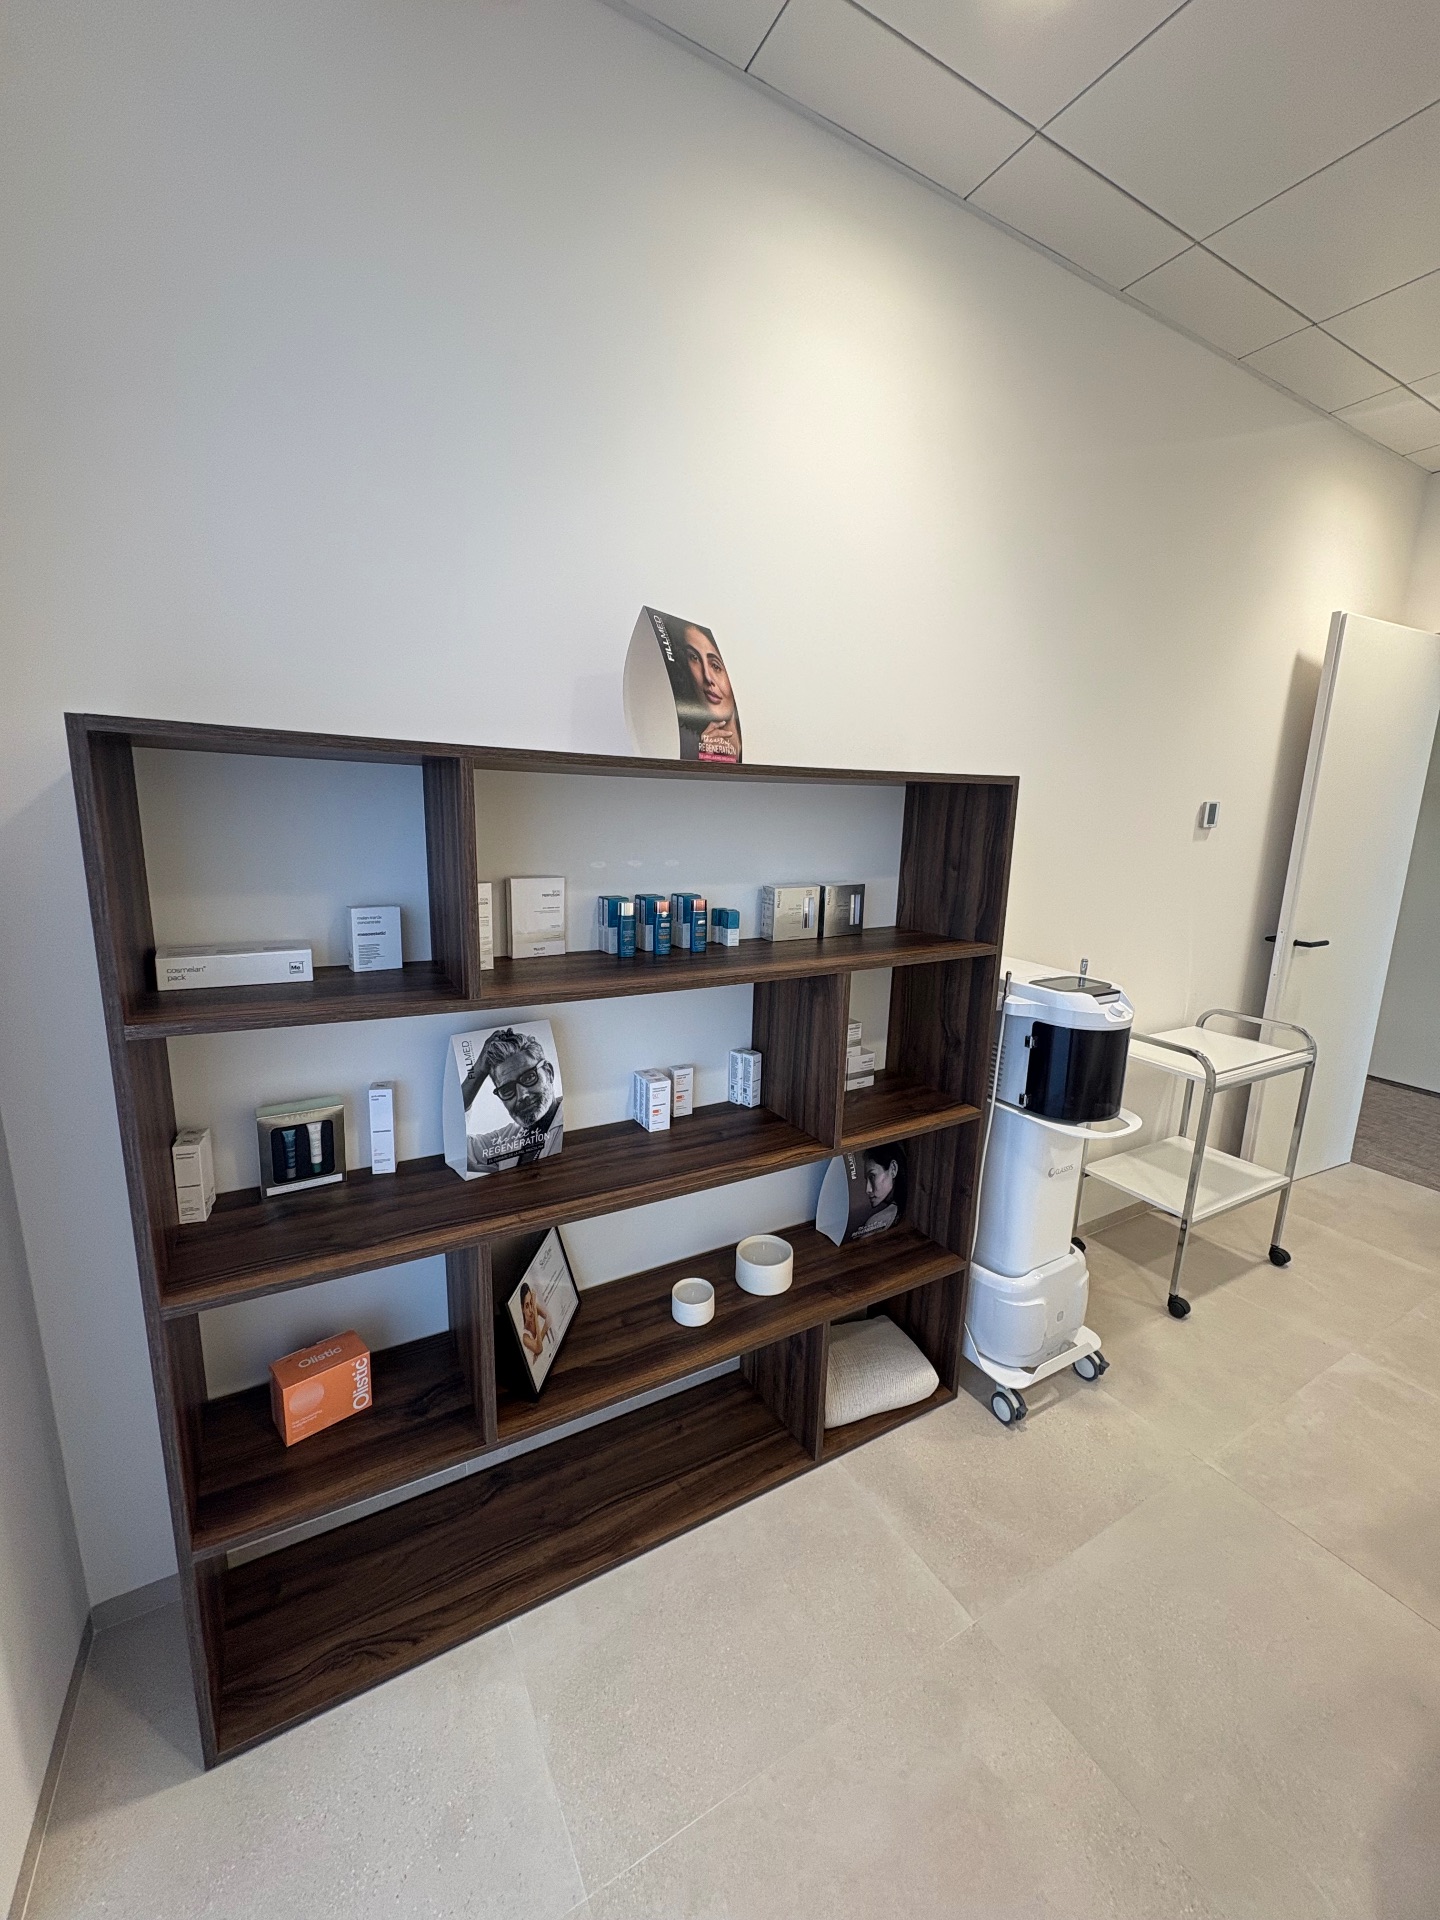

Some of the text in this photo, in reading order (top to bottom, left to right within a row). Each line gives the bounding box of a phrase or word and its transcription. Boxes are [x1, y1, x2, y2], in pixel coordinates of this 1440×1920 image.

[653, 615, 675, 662] FILLMED
[698, 742, 737, 755] REGENERATION
[461, 1040, 476, 1080] FILLMED
[482, 1132, 550, 1158] REGENERATION
[298, 1347, 342, 1368] Olistic
[352, 1357, 370, 1410] Olistic
